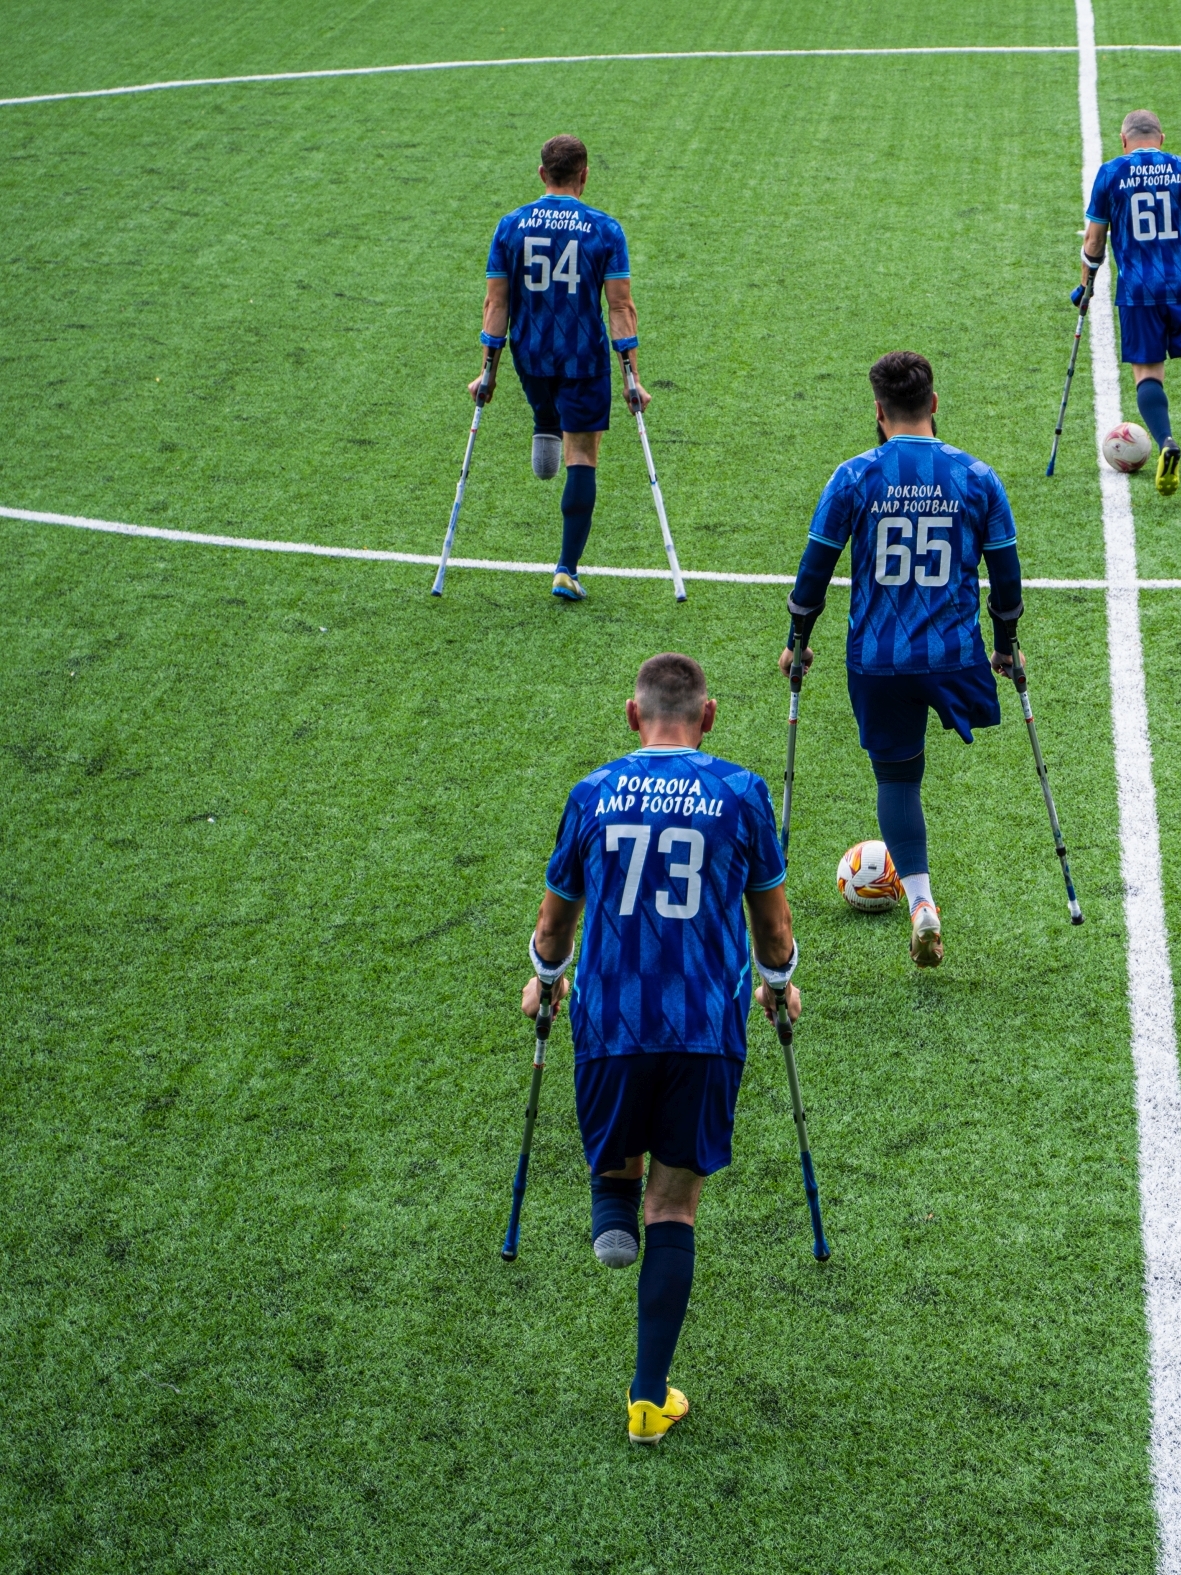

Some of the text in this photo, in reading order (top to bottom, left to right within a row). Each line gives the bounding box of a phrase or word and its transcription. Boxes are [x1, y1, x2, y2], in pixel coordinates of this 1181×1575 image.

[1130, 163, 1173, 176] POKROVA
[1119, 177, 1140, 189] AMP
[532, 208, 579, 220] POKROVA
[1130, 191, 1179, 241] 61
[518, 218, 592, 233] AMP FOOTBALL
[524, 236, 581, 294] 54
[887, 484, 943, 498] POKROVA
[870, 500, 959, 514] AMP FOOTBALL
[875, 516, 953, 587] 65
[616, 774, 701, 796] POKROVA
[594, 795, 724, 817] AMP FOOTBALL
[605, 824, 705, 920] 73
